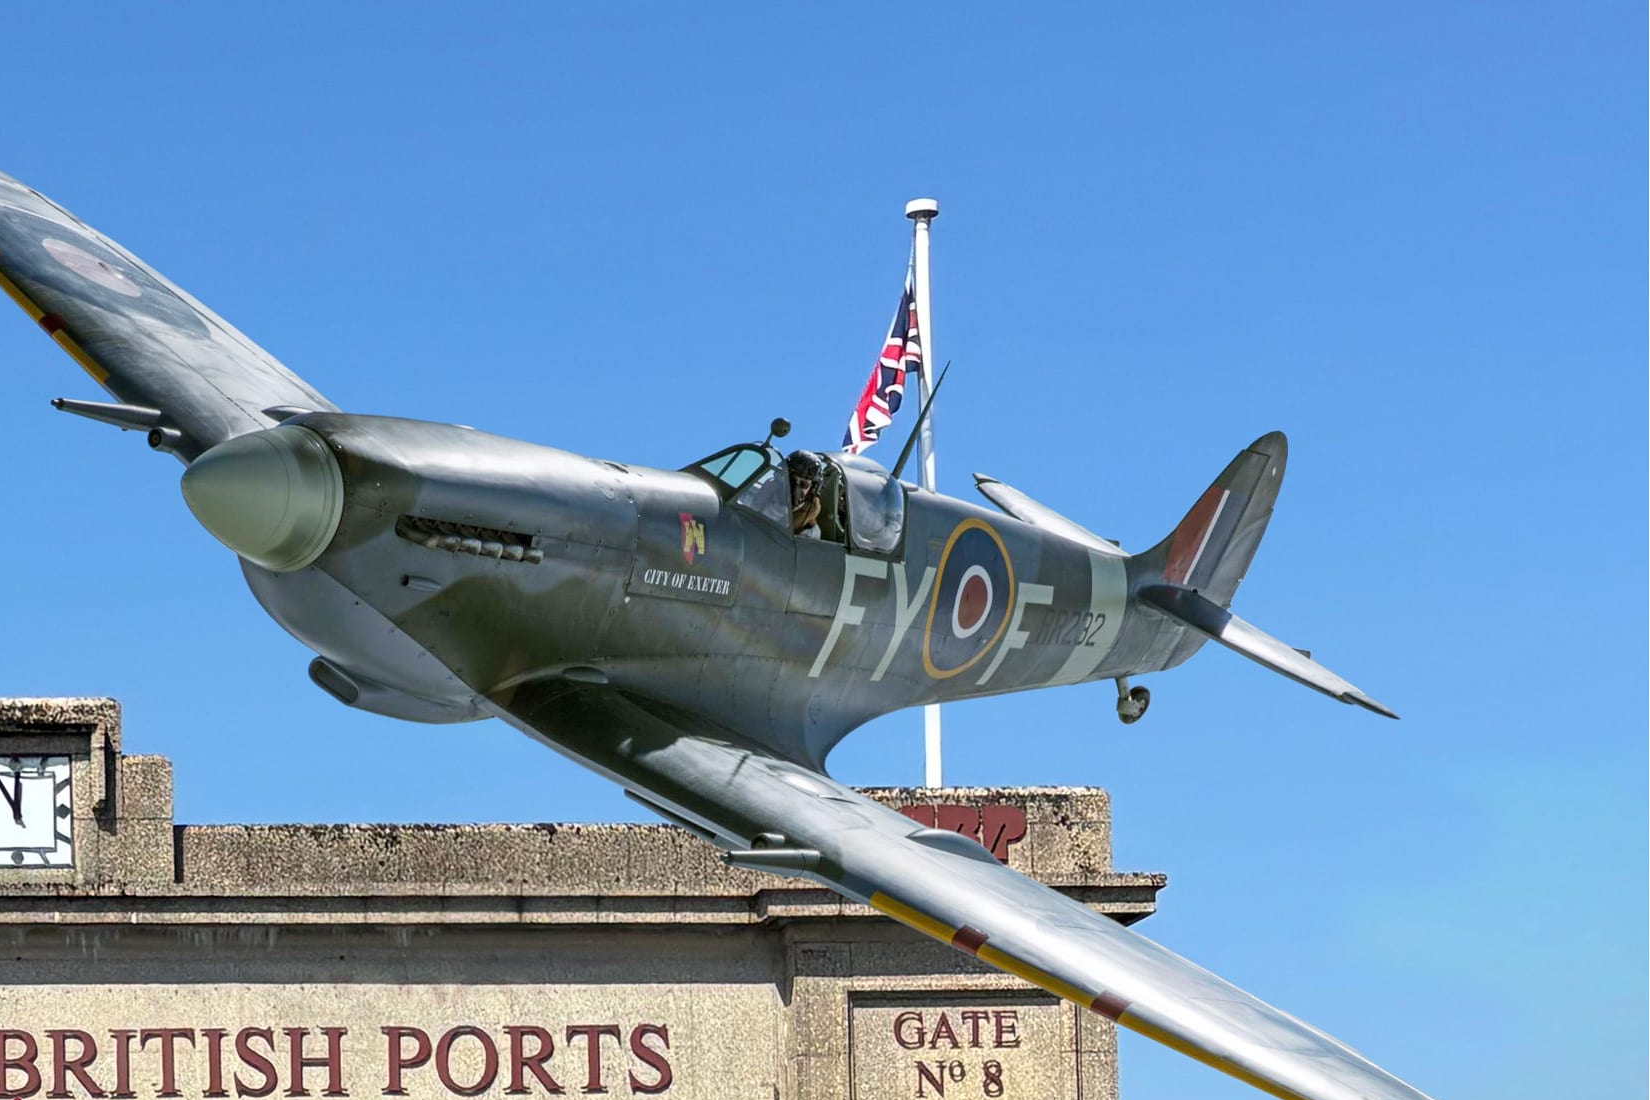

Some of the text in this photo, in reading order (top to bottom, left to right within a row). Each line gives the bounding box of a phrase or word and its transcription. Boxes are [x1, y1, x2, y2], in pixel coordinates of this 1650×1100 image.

[644, 568, 730, 596] CITY OF EXETER
[807, 553, 1055, 686] FY F
[893, 1010, 1022, 1050] GATE
[380, 1022, 674, 1096] PORTS
[982, 1059, 1005, 1099] 8
